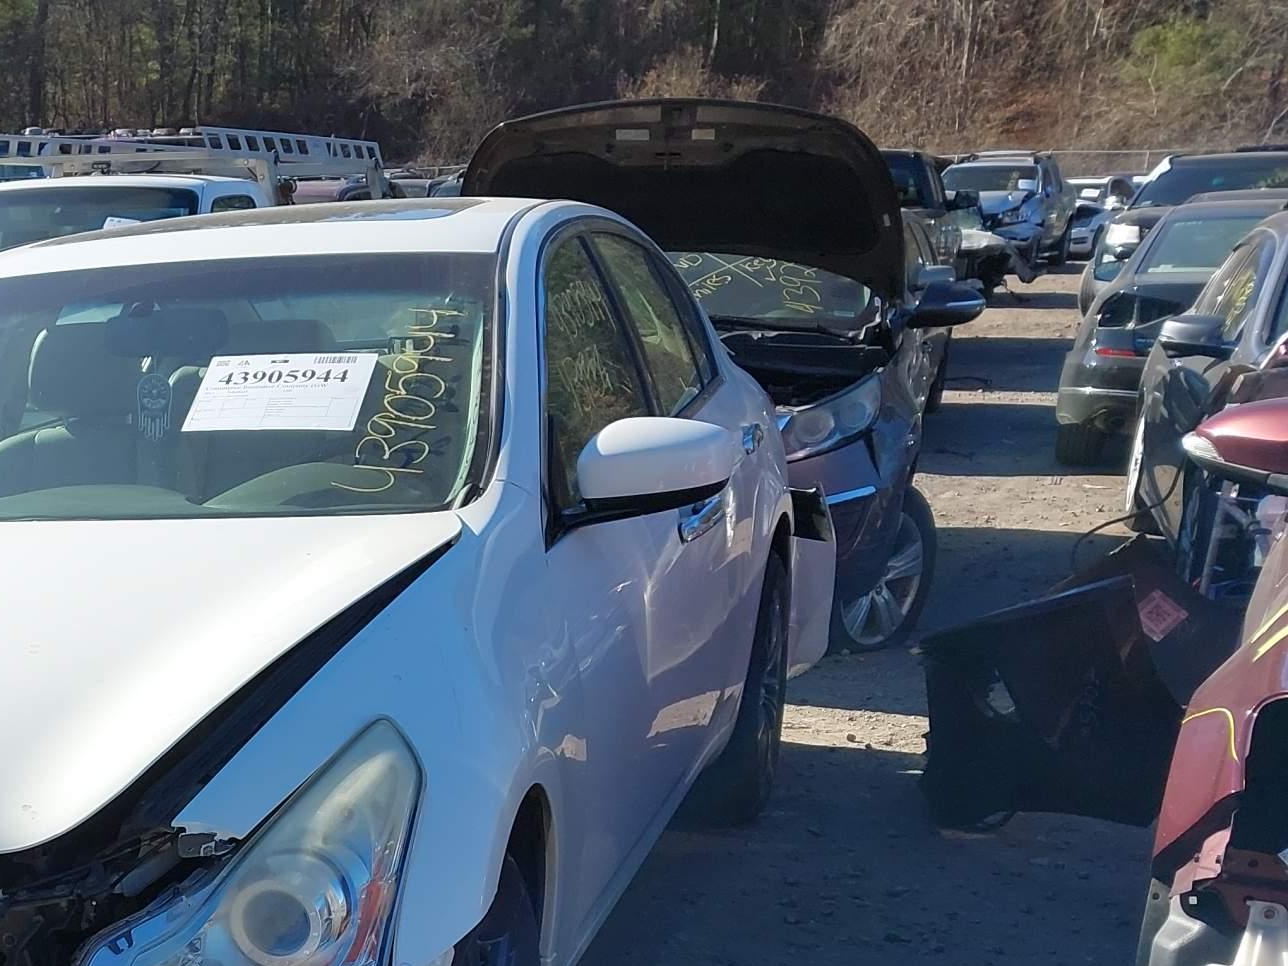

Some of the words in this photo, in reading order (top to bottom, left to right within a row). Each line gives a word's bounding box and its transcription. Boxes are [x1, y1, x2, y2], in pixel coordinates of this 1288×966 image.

[779, 260, 824, 314] 4392
[218, 368, 349, 385] 43905944
[330, 307, 465, 492] 43905944
